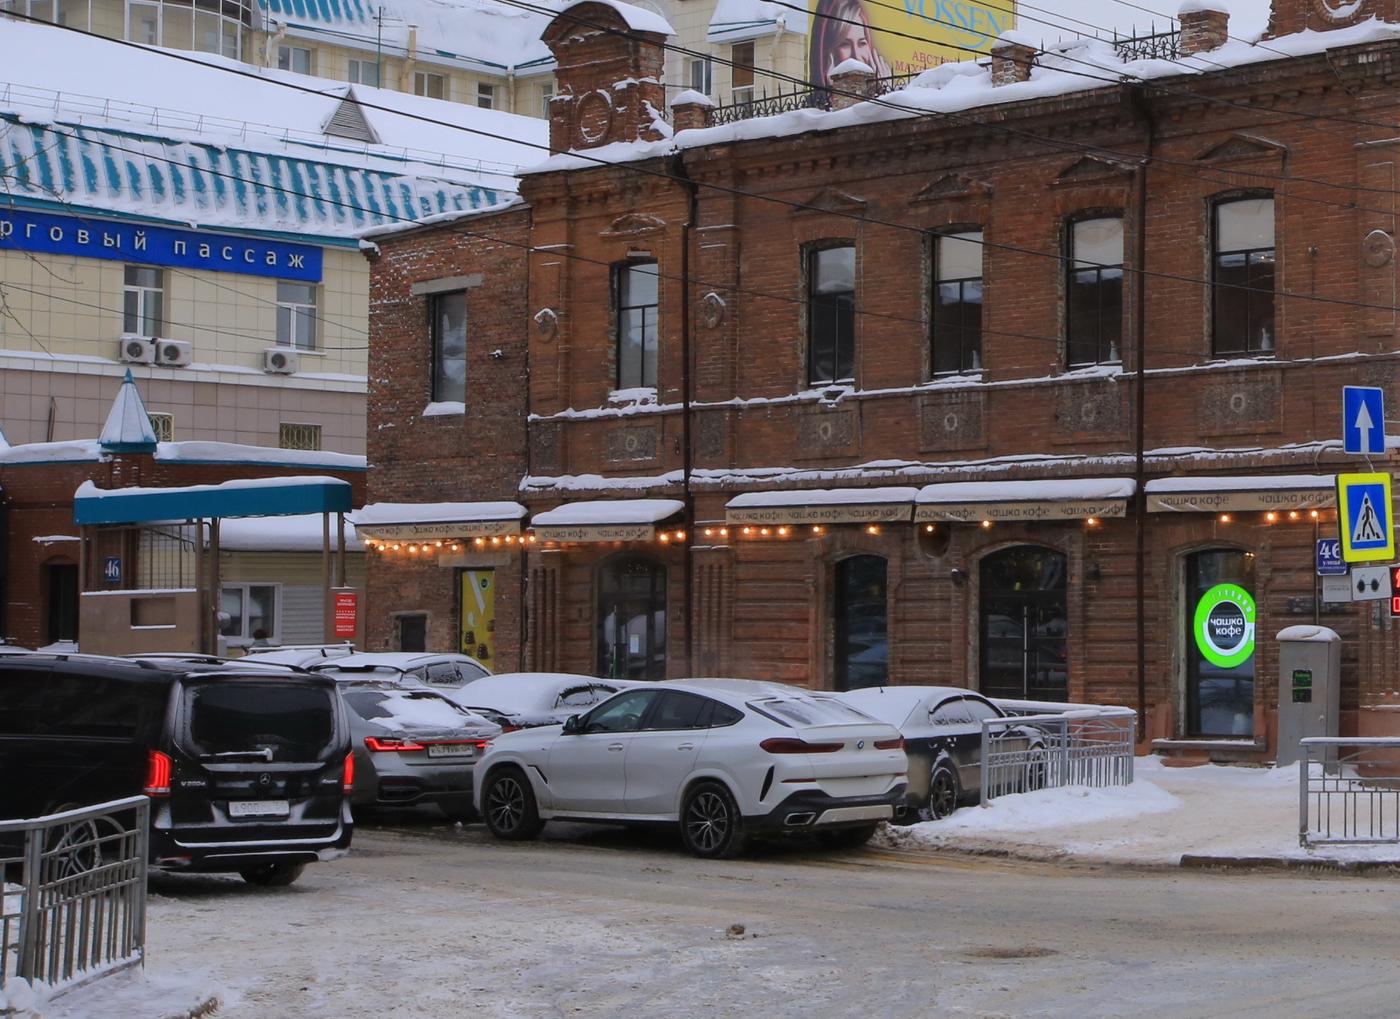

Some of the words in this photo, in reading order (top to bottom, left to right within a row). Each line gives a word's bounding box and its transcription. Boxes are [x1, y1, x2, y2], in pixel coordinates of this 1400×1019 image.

[902, 0, 1008, 36] VOSSEN
[173, 239, 305, 269] пассаж
[1160, 495, 1197, 506] чашка
[1200, 493, 1230, 507] кофе
[1258, 493, 1299, 504] чашка
[1301, 492, 1334, 504] кофе
[986, 508, 1020, 517] чашка
[1022, 506, 1050, 518] кофе
[1061, 505, 1096, 515] чашка
[1319, 542, 1340, 559] 46
[105, 560, 120, 577] 46
[1210, 617, 1243, 626] чашка
[1215, 625, 1242, 638] кофе
